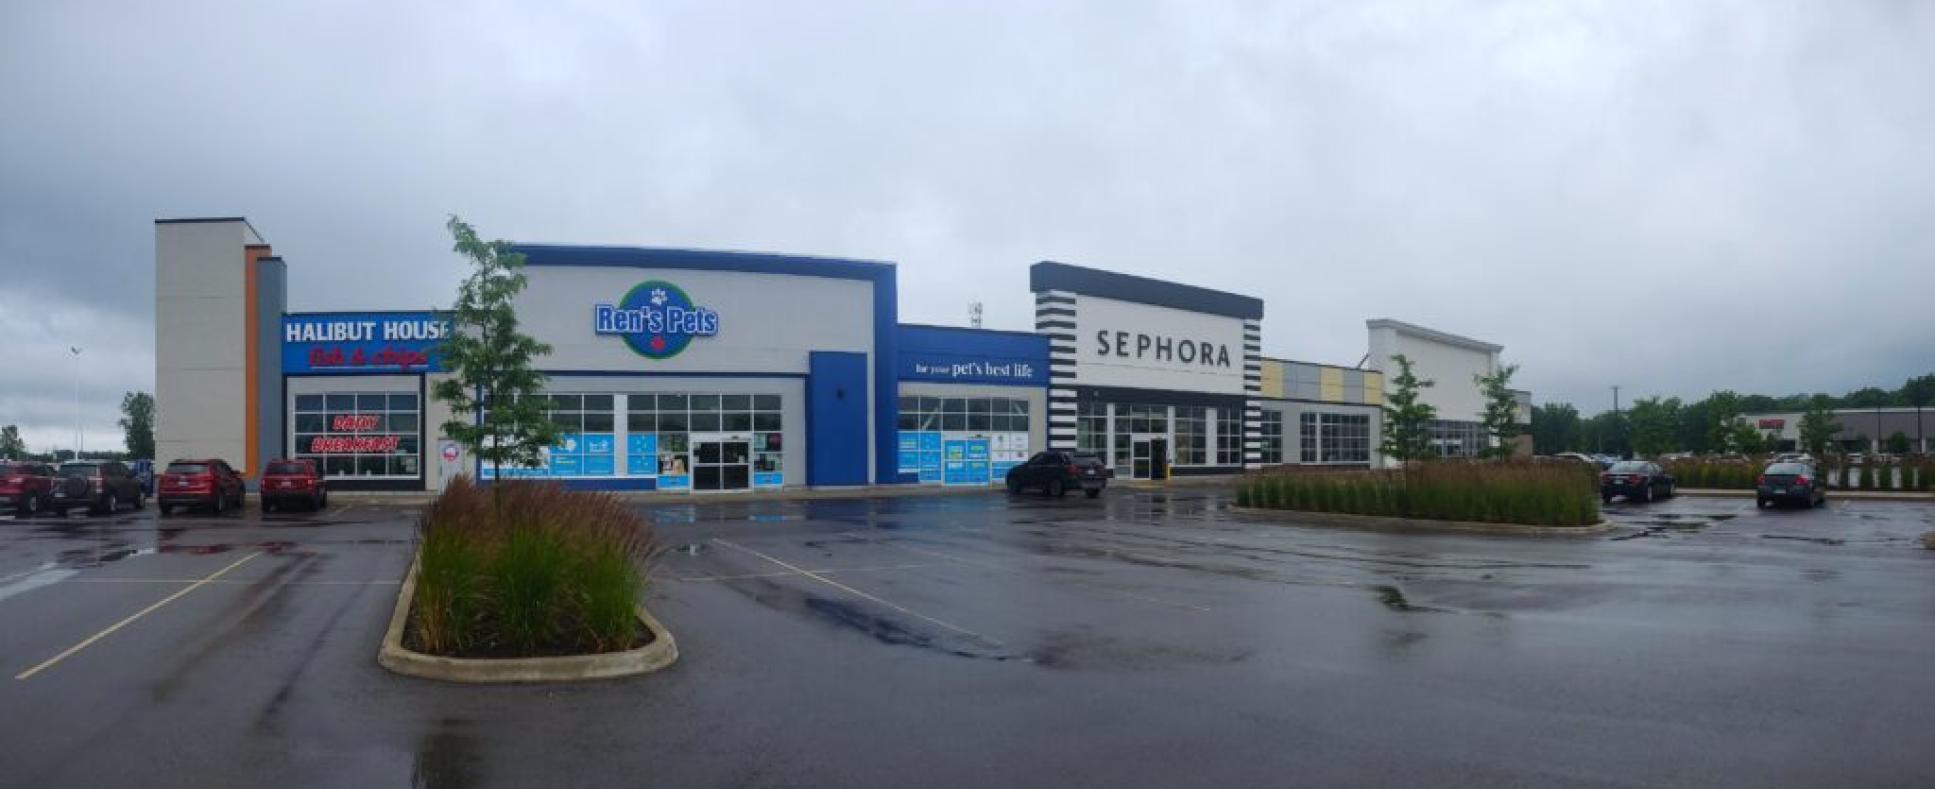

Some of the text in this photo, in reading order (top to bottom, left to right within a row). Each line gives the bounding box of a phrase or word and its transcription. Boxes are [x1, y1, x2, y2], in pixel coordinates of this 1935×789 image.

[596, 305, 718, 335] Ren's Pets
[286, 322, 376, 342] HALIBUT
[1097, 329, 1230, 368] SEPHORA
[952, 362, 982, 377] pet's
[985, 362, 1010, 376] best
[1014, 363, 1033, 378] life
[312, 436, 399, 452] BREAKFAST
